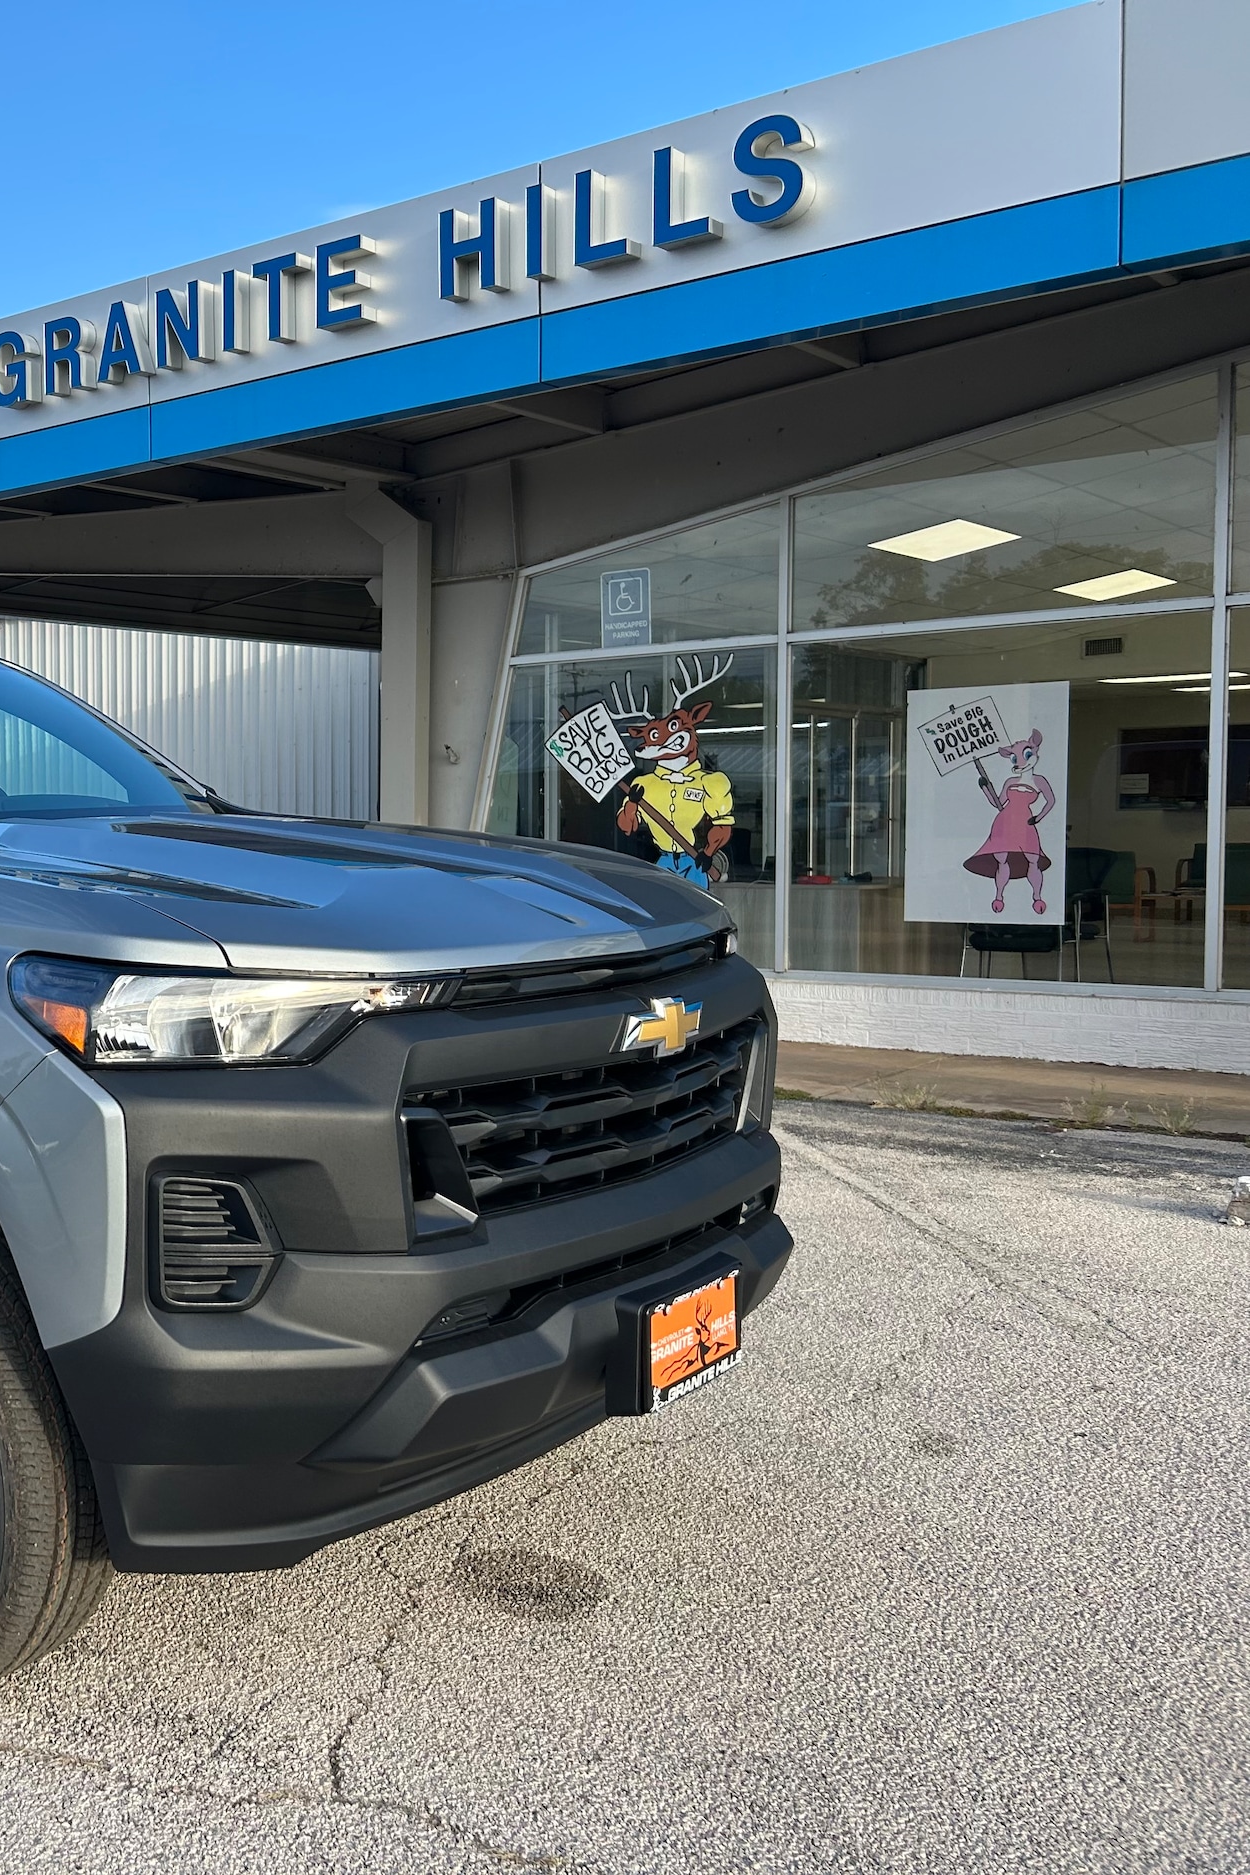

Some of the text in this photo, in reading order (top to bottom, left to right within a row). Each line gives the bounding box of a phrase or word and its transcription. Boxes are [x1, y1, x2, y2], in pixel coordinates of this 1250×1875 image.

[438, 113, 816, 302] HILLS
[604, 620, 648, 630] HANDICAPPED
[613, 630, 639, 638] PARKING
[558, 707, 608, 751] SAVE
[936, 706, 984, 733] Save BIG
[933, 715, 994, 754] DOUGH
[955, 731, 1000, 758] LLANO!
[567, 731, 616, 775] BIG
[584, 748, 631, 794] BUCKS
[686, 789, 702, 800] SPIKE
[710, 1310, 736, 1333] HILLS
[651, 1332, 695, 1364] GRANITE
[657, 1328, 685, 1346] CHEVROLET
[667, 1349, 743, 1402] GRANITE HILLS
